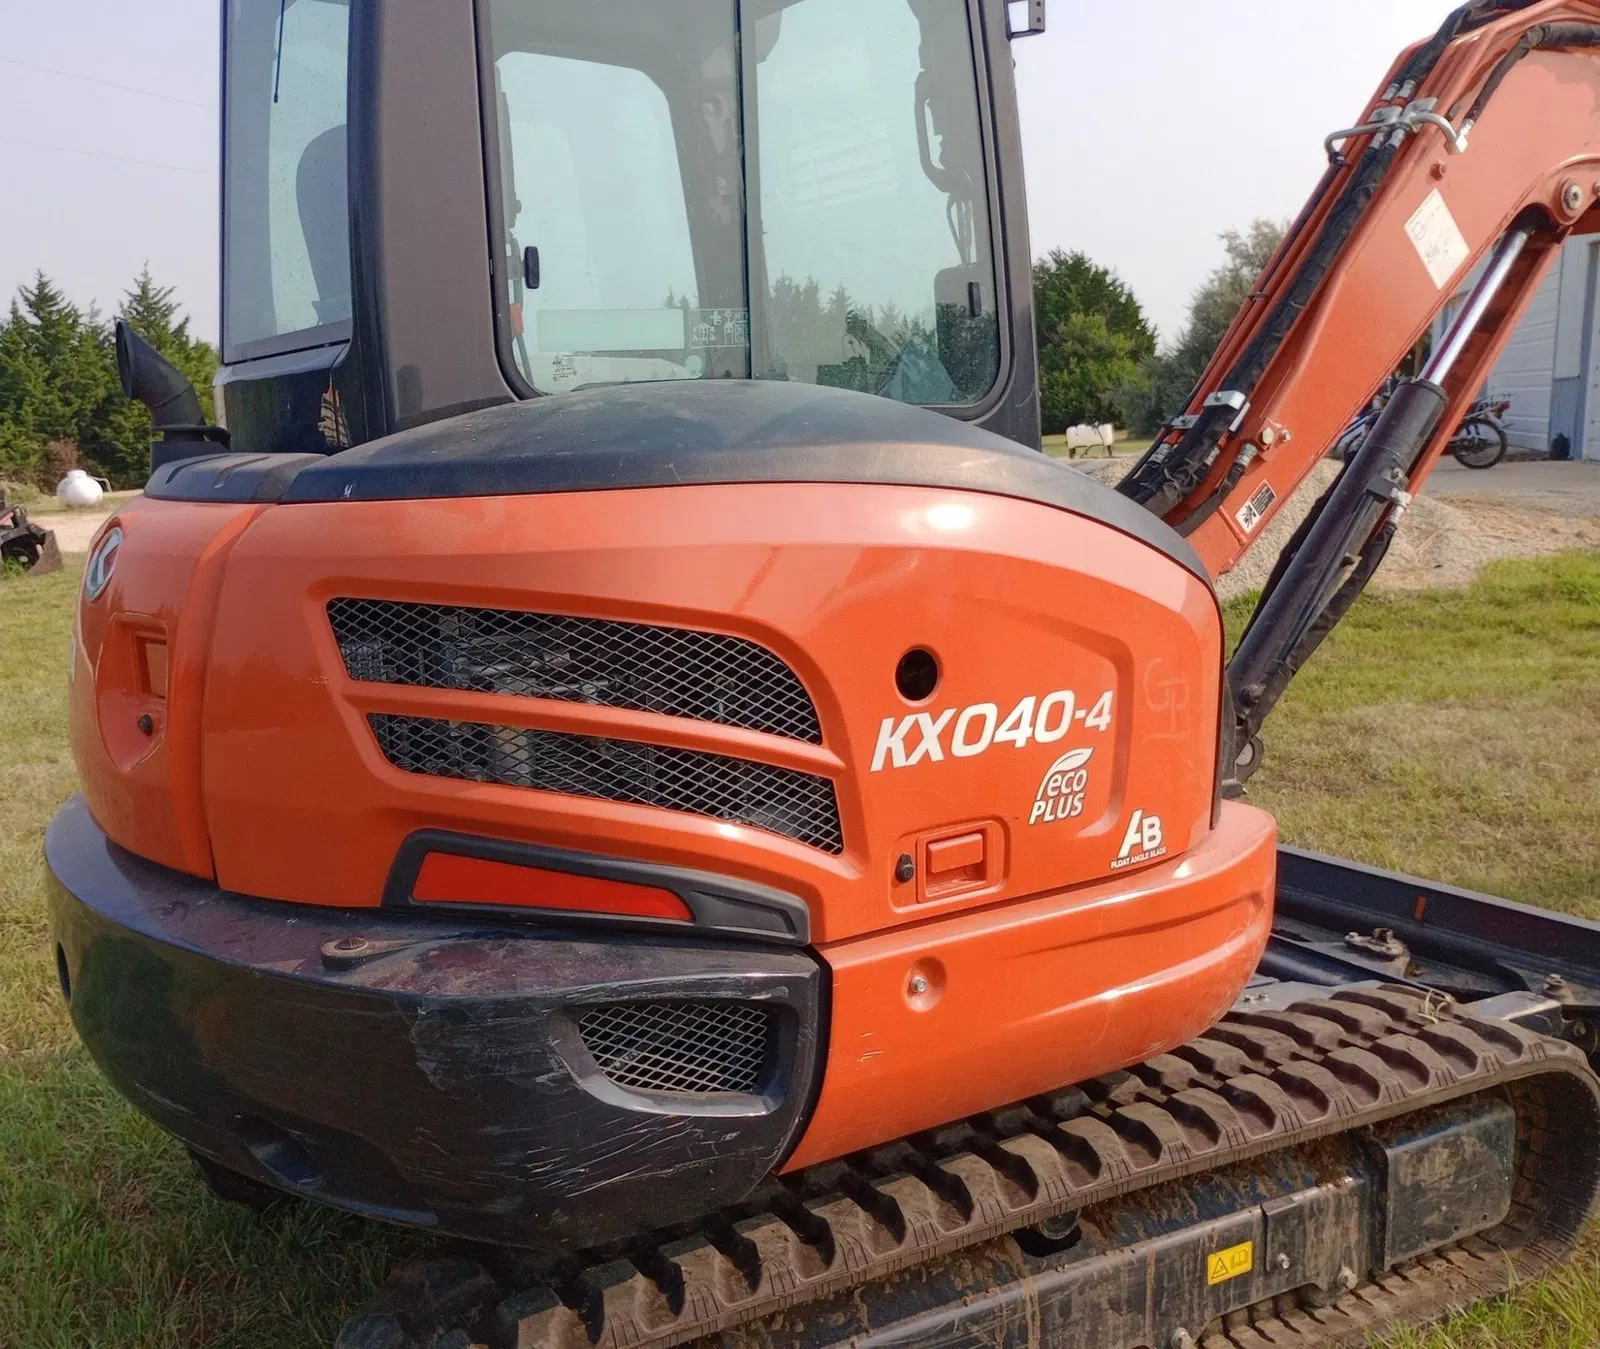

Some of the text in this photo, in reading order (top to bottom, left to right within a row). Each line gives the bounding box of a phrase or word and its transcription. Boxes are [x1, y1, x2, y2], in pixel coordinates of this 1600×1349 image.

[869, 689, 1114, 772] KX040-4
[1046, 769, 1087, 797] eco
[1028, 794, 1086, 825] PLUS
[1110, 846, 1167, 870] FLOAT ANGLE BLADE
